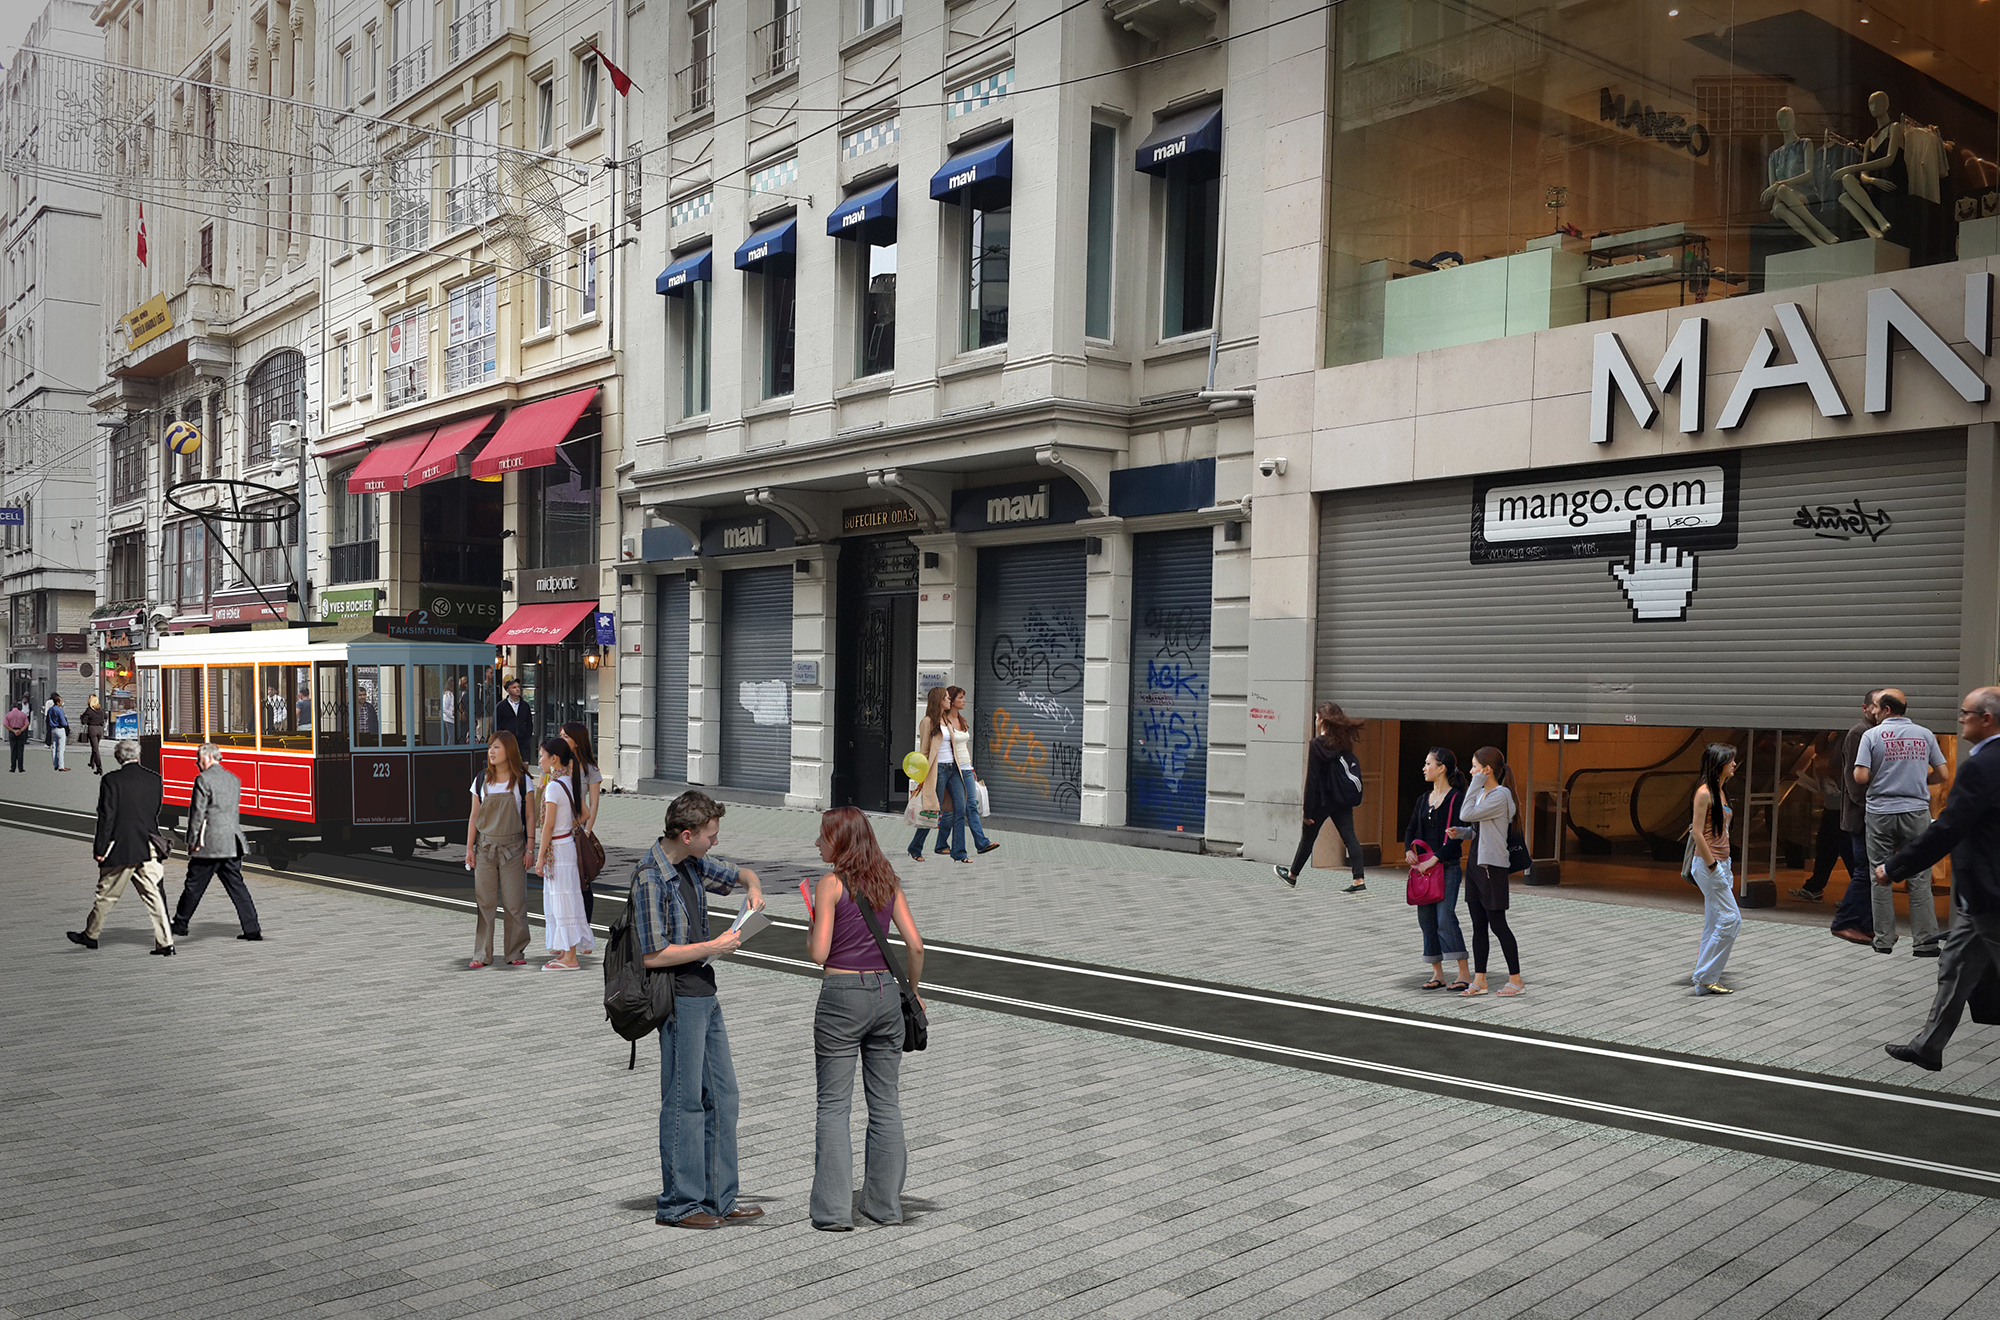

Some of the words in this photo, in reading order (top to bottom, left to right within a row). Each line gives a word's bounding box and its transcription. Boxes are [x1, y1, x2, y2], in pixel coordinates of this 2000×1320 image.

[1153, 136, 1186, 161] mavi
[948, 166, 976, 189] mavi
[842, 206, 865, 228] mavi
[748, 242, 768, 262] mavi
[668, 270, 686, 287] mavi
[1589, 272, 1993, 444] MAN
[422, 464, 440, 480] midpoint
[498, 456, 523, 471] midpoint
[365, 479, 386, 491] midpoint
[987, 484, 1050, 524] mavi
[1499, 479, 1706, 527] mango.com
[723, 518, 766, 549] mavi
[536, 576, 576, 593] midpoint
[330, 601, 345, 613] YVES
[346, 600, 373, 612] ROCHER
[455, 603, 497, 615] YVES
[418, 611, 428, 624] 2
[390, 624, 456, 635] TAKSİM-TÜNEL
[1884, 740, 1905, 748] TEM
[373, 763, 391, 777] 223
